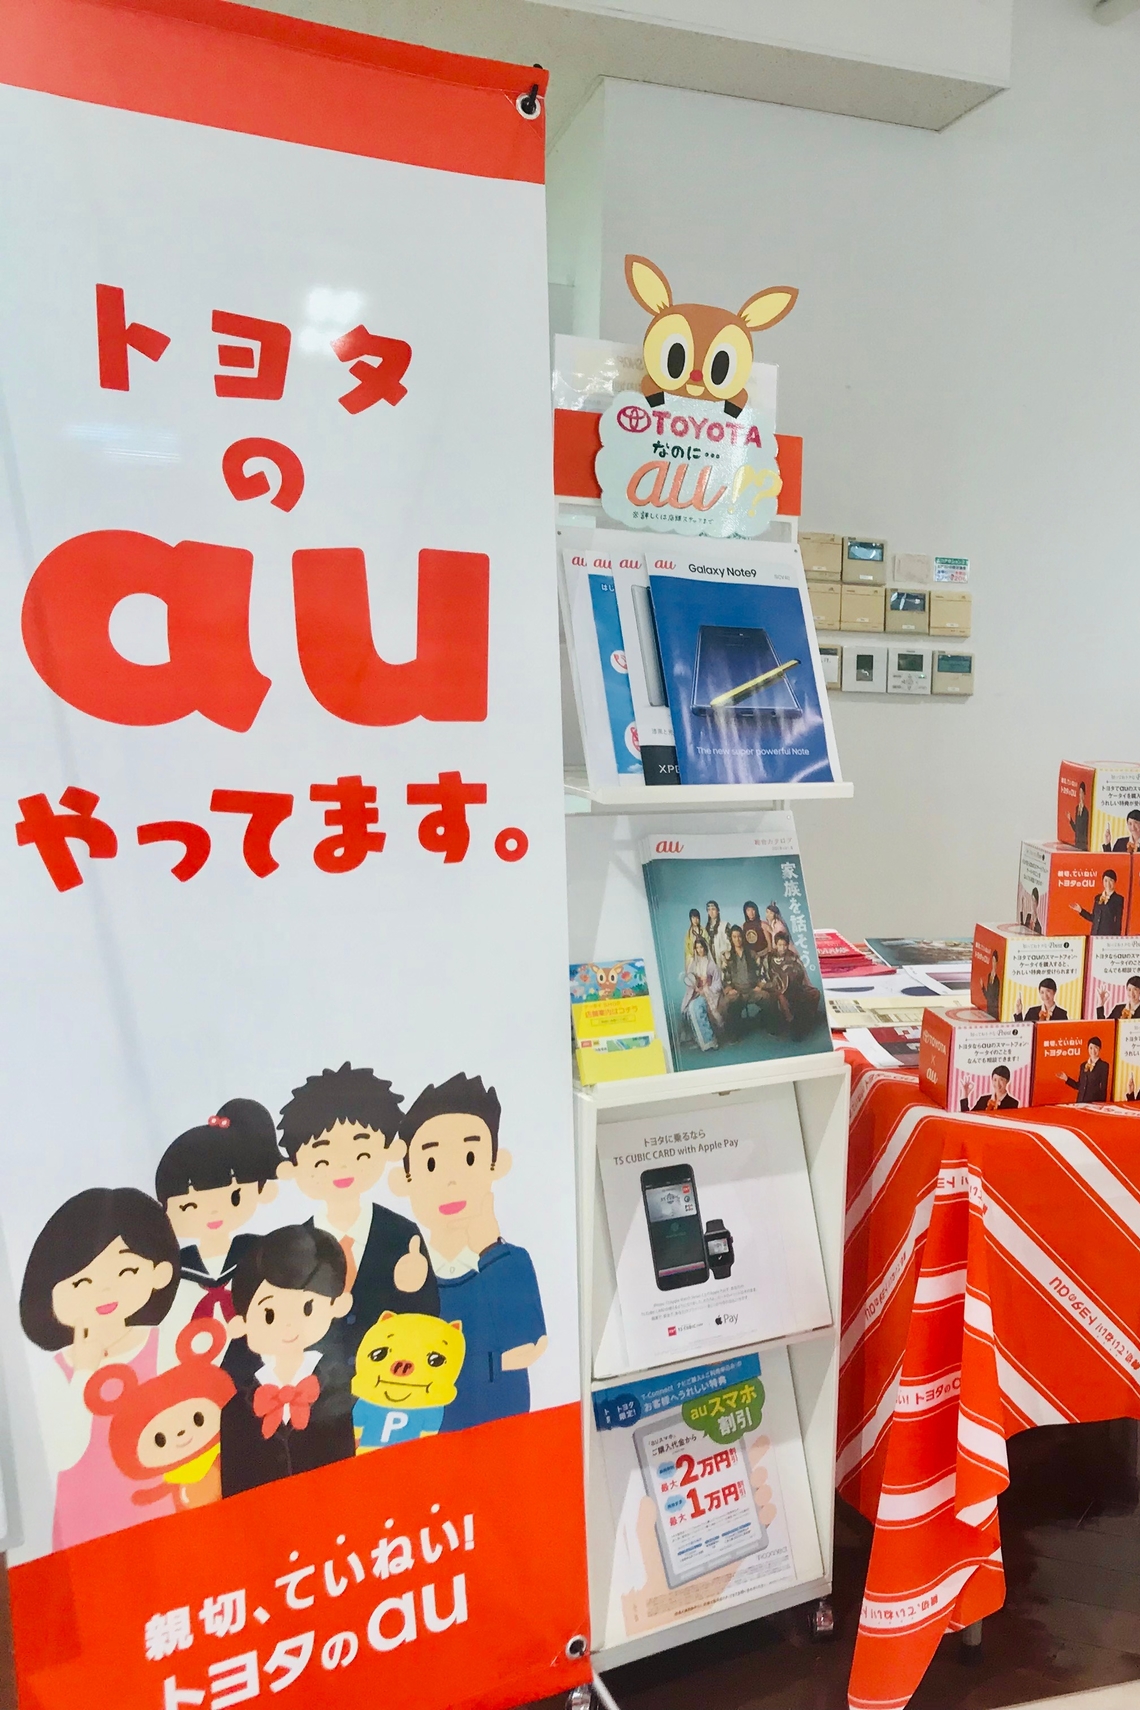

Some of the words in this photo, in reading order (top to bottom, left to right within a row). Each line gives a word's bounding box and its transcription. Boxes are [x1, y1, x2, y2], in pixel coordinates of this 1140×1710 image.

[96, 283, 413, 415] トヨタ
[652, 410, 763, 448] TOYOTA
[222, 437, 305, 513] の
[619, 558, 642, 570] au
[654, 559, 676, 570] au
[688, 563, 725, 578] Galaxy
[727, 566, 757, 578] Note9
[21, 529, 490, 733] au
[697, 747, 711, 755] The
[791, 748, 810, 756] Note
[16, 771, 529, 892] やってます。
[655, 840, 685, 854] au
[780, 861, 817, 972] 家族を話そう。
[614, 1156, 624, 1165] TS
[626, 1152, 651, 1163] CUBIC
[653, 1148, 676, 1160] CARD
[678, 1145, 696, 1156] with
[698, 1140, 723, 1153] Apple
[724, 1138, 739, 1148] Pay
[644, 1129, 706, 1147] トヨタに乗るなら
[723, 1313, 739, 1324] Pay
[644, 1375, 728, 1413] お客様へうれしい特典
[690, 1384, 757, 1420] auスマホ
[717, 1407, 753, 1437] 割引
[651, 1434, 697, 1457] ご購入代金から
